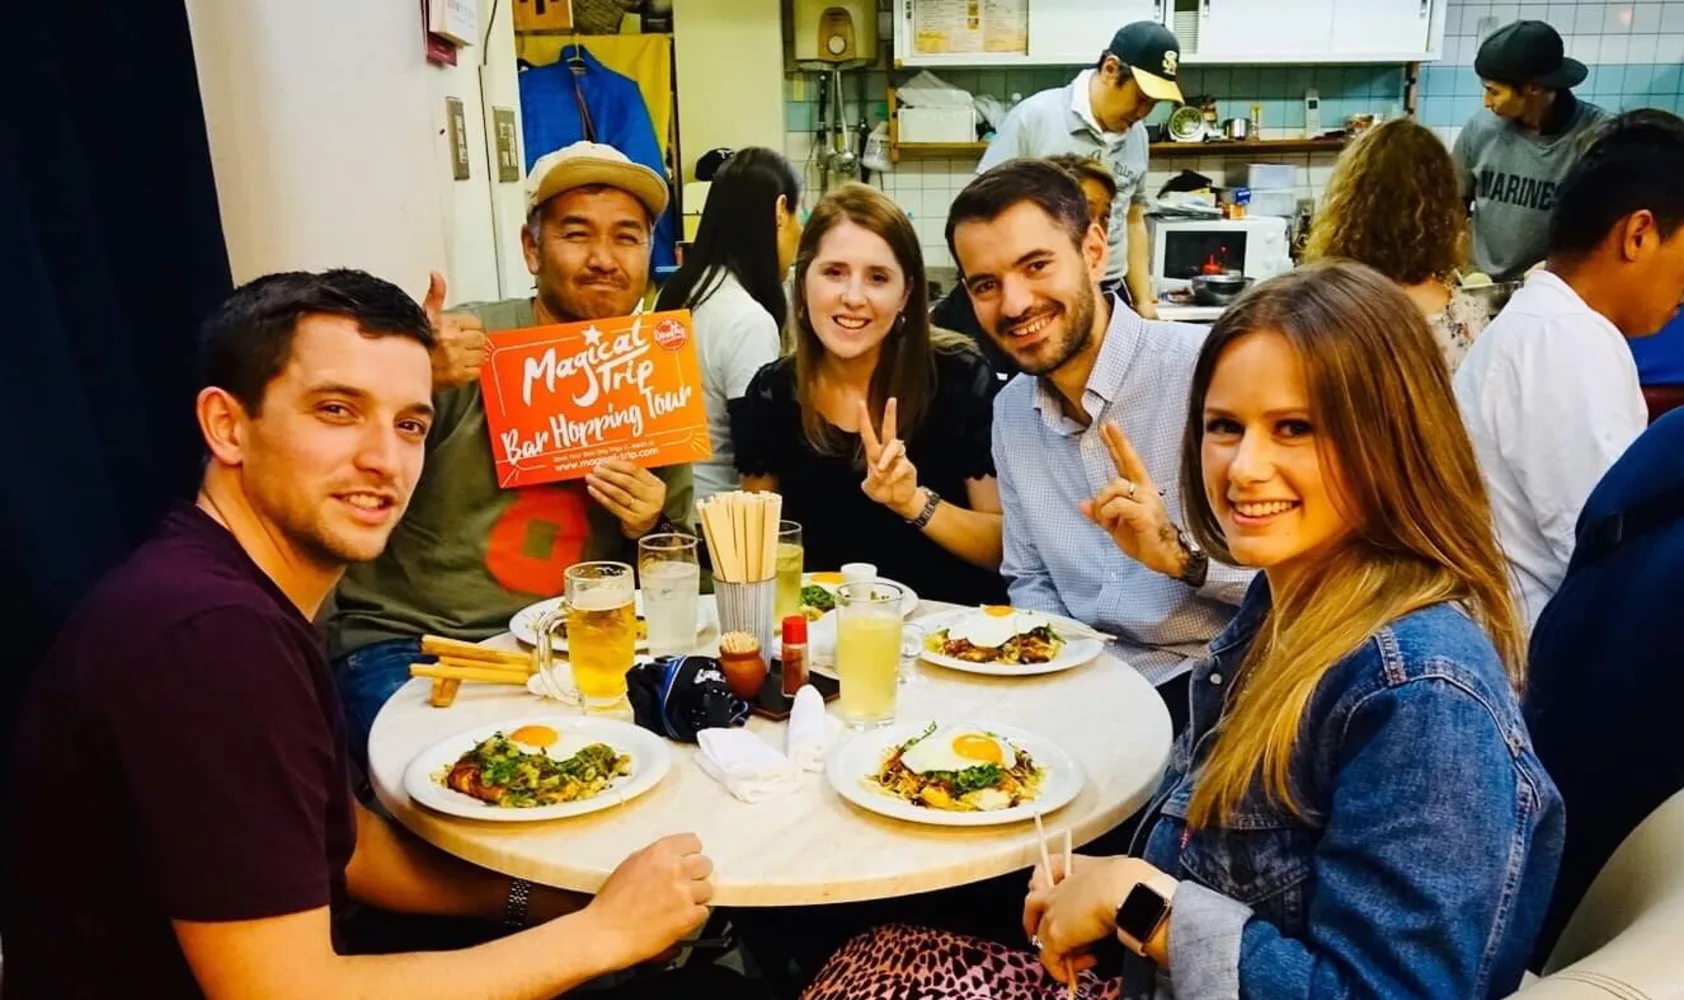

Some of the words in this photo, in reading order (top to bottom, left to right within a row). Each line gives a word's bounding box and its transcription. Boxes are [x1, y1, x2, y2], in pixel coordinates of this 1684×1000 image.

[1480, 168, 1559, 211] MARINE
[523, 319, 647, 407] Magical
[596, 359, 654, 394] Trip
[501, 428, 548, 466] Bar
[550, 404, 643, 449] Hopping
[640, 386, 692, 419] Tour
[555, 447, 659, 472] www.magl-trip.com
